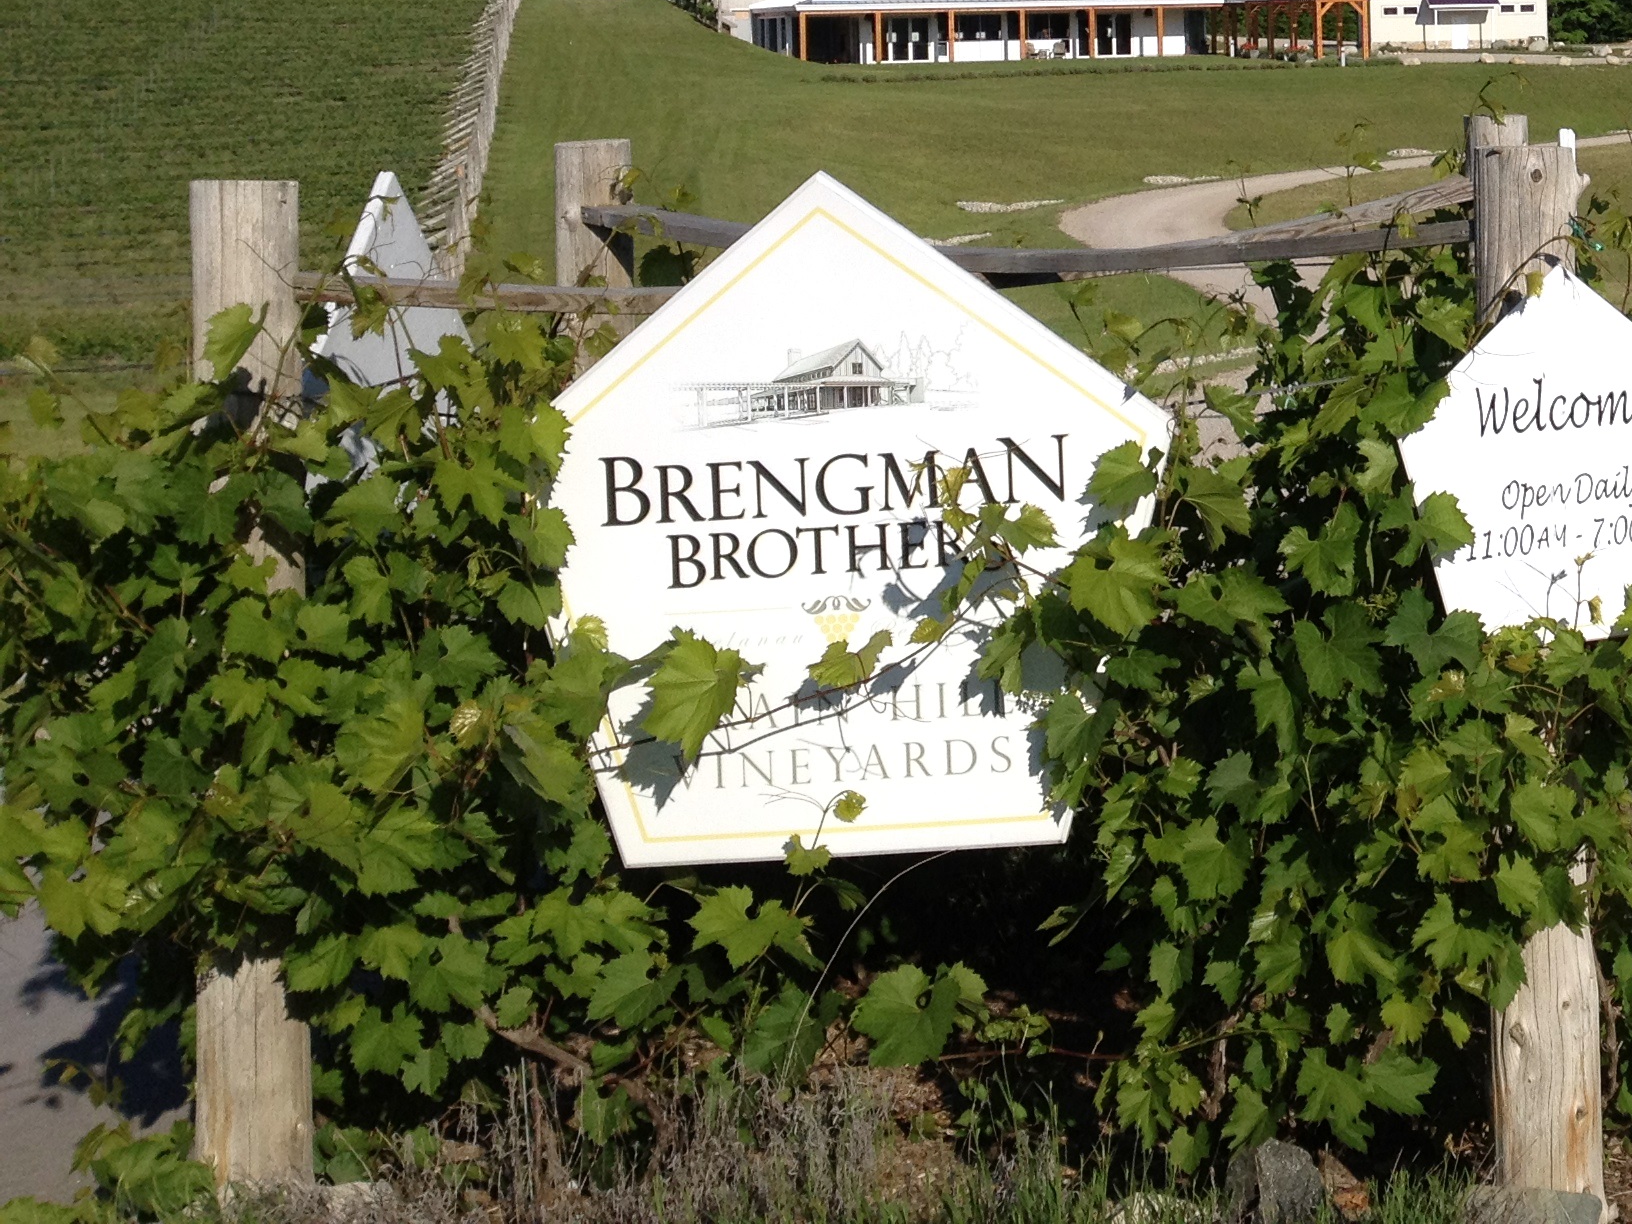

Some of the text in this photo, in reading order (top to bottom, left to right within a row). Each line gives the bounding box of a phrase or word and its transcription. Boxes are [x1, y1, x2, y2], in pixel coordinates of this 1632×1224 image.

[598, 434, 1070, 527] BRENGMAN
[1502, 479, 1571, 519] Open
[673, 735, 1013, 790] VINEYARDS
